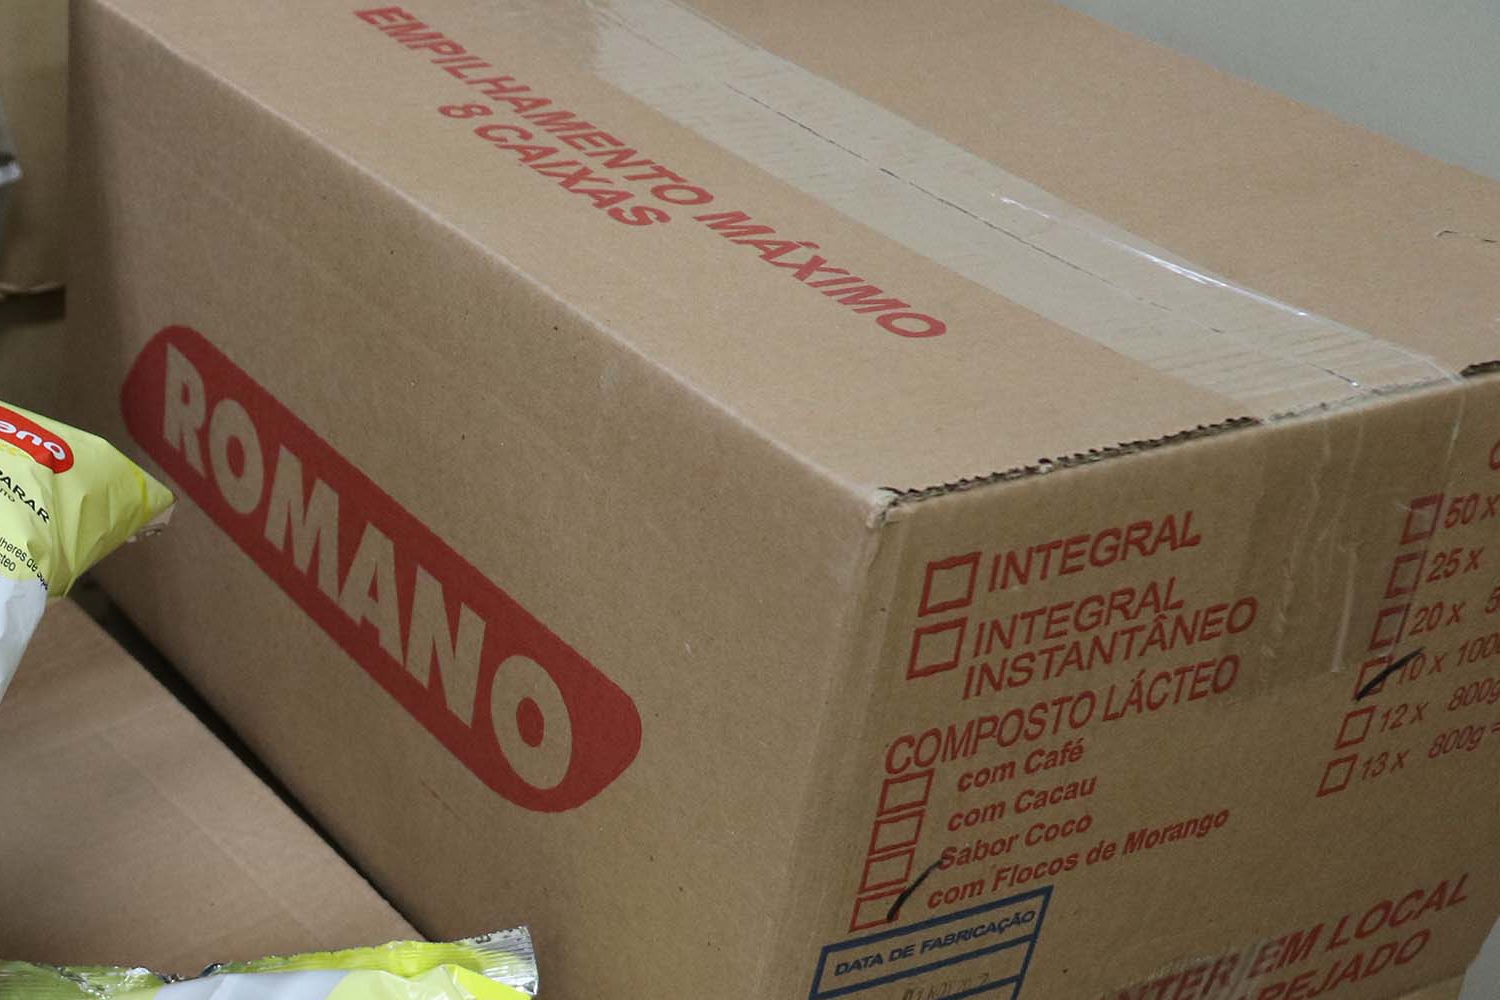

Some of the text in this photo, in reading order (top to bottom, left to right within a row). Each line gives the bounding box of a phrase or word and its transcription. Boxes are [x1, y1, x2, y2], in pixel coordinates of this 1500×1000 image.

[355, 6, 947, 339] EMPILHAMENTO MÁXIMO
[438, 102, 671, 228] 8 CAIXAS
[1444, 493, 1480, 529] 50
[163, 343, 573, 791] ROMANO
[988, 511, 1201, 593] INTEGRAL
[1427, 549, 1463, 583] 25
[962, 597, 1258, 700] INSTANTÂNEO
[973, 577, 1184, 658] INTEGRAL
[1409, 602, 1444, 636] 20
[885, 654, 1240, 774] COMPOSTO LÁCTEO
[1378, 703, 1409, 733] 12
[957, 738, 1085, 793] com Café
[1361, 725, 1485, 781] 13 800g
[947, 775, 1097, 832] com Cacau
[927, 809, 1230, 909] com Flocos de Morango
[938, 815, 1092, 871] Sabor Coco
[834, 910, 1036, 976] DATA DE FABRICAÇÃO
[1248, 923, 1326, 979] EM
[1325, 873, 1468, 952] LOCAL
